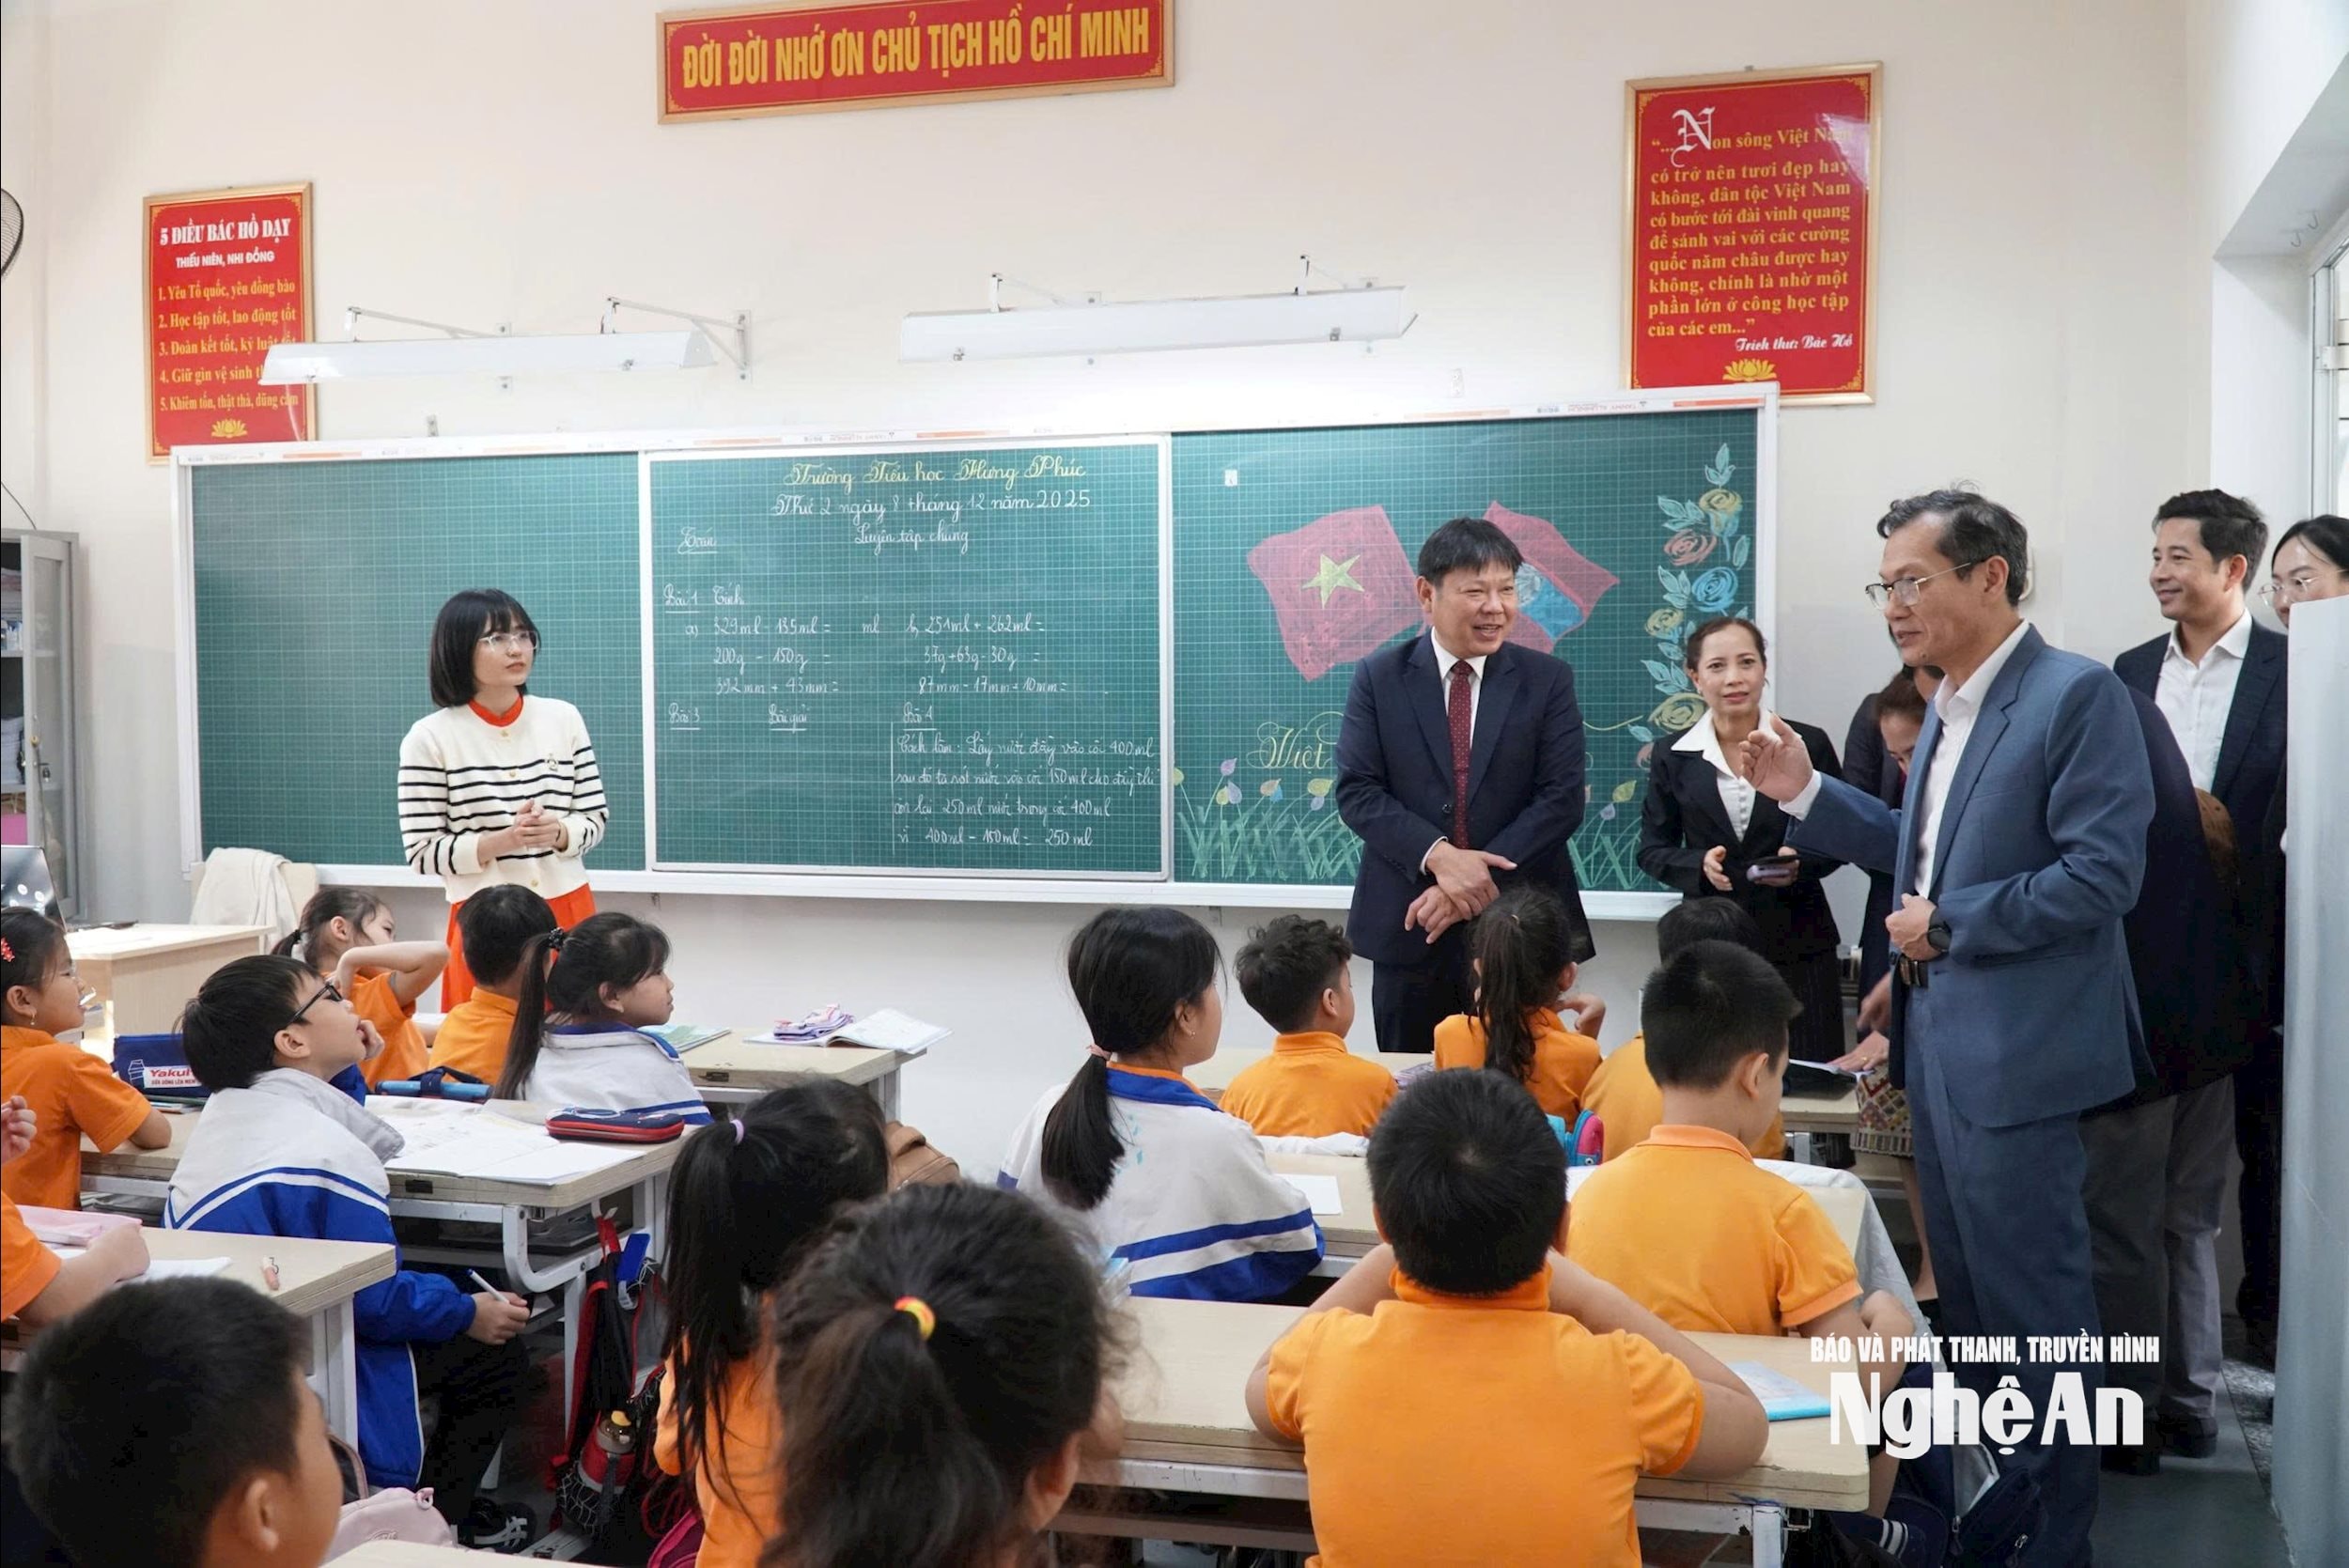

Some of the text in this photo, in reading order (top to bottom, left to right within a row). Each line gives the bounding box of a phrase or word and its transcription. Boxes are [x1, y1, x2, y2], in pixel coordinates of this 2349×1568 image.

[683, 4, 1148, 88] ĐỜI ĐỜI NHỚ ƠN CHỦ TỊCH HỒ CHÍ MINH
[1736, 132, 1772, 149] sông
[1778, 128, 1809, 148] Việt
[1652, 158, 1849, 184] có trở nên tươi đẹp hay
[1652, 181, 1850, 207] không, dân tộc Việt Nam
[160, 213, 291, 245] 5 ĐIỀU BÁC HỒ DẠY
[1651, 206, 1850, 227] có bước tới đài vinh quang
[1650, 226, 1850, 250] để sánh vai với các cường
[176, 247, 274, 268] THIẾU NIÊN, NHI ĐỒNG
[1650, 249, 1850, 275] quốc năm châu được hay
[158, 276, 295, 301] 1. Yêu Tổ quốc, yêu đồng bào
[1650, 269, 1848, 296] không, chính là nhờ một
[159, 303, 296, 331] 2. Học tập tốt, lao động tốt
[1649, 291, 1849, 319] phần lớn ở công học tập
[1648, 321, 1675, 337] của
[1680, 321, 1704, 336] các
[159, 341, 168, 356] 3.
[171, 340, 197, 355] Đoàn
[201, 334, 217, 353] kết
[221, 334, 238, 353] tốt,
[160, 370, 169, 383] 4.
[172, 367, 193, 383] Giữ
[195, 367, 211, 385] gìn
[215, 365, 227, 383] vệ
[230, 365, 253, 380] sinh
[770, 493, 814, 517] Thứ
[820, 496, 832, 515] 2
[839, 499, 886, 528] ngày
[908, 491, 961, 522] tháng
[967, 492, 985, 510] 12
[991, 494, 1034, 510] năm
[1035, 489, 1091, 509] 2025
[1247, 721, 1333, 776] Việt
[150, 1068, 191, 1078] Yakul
